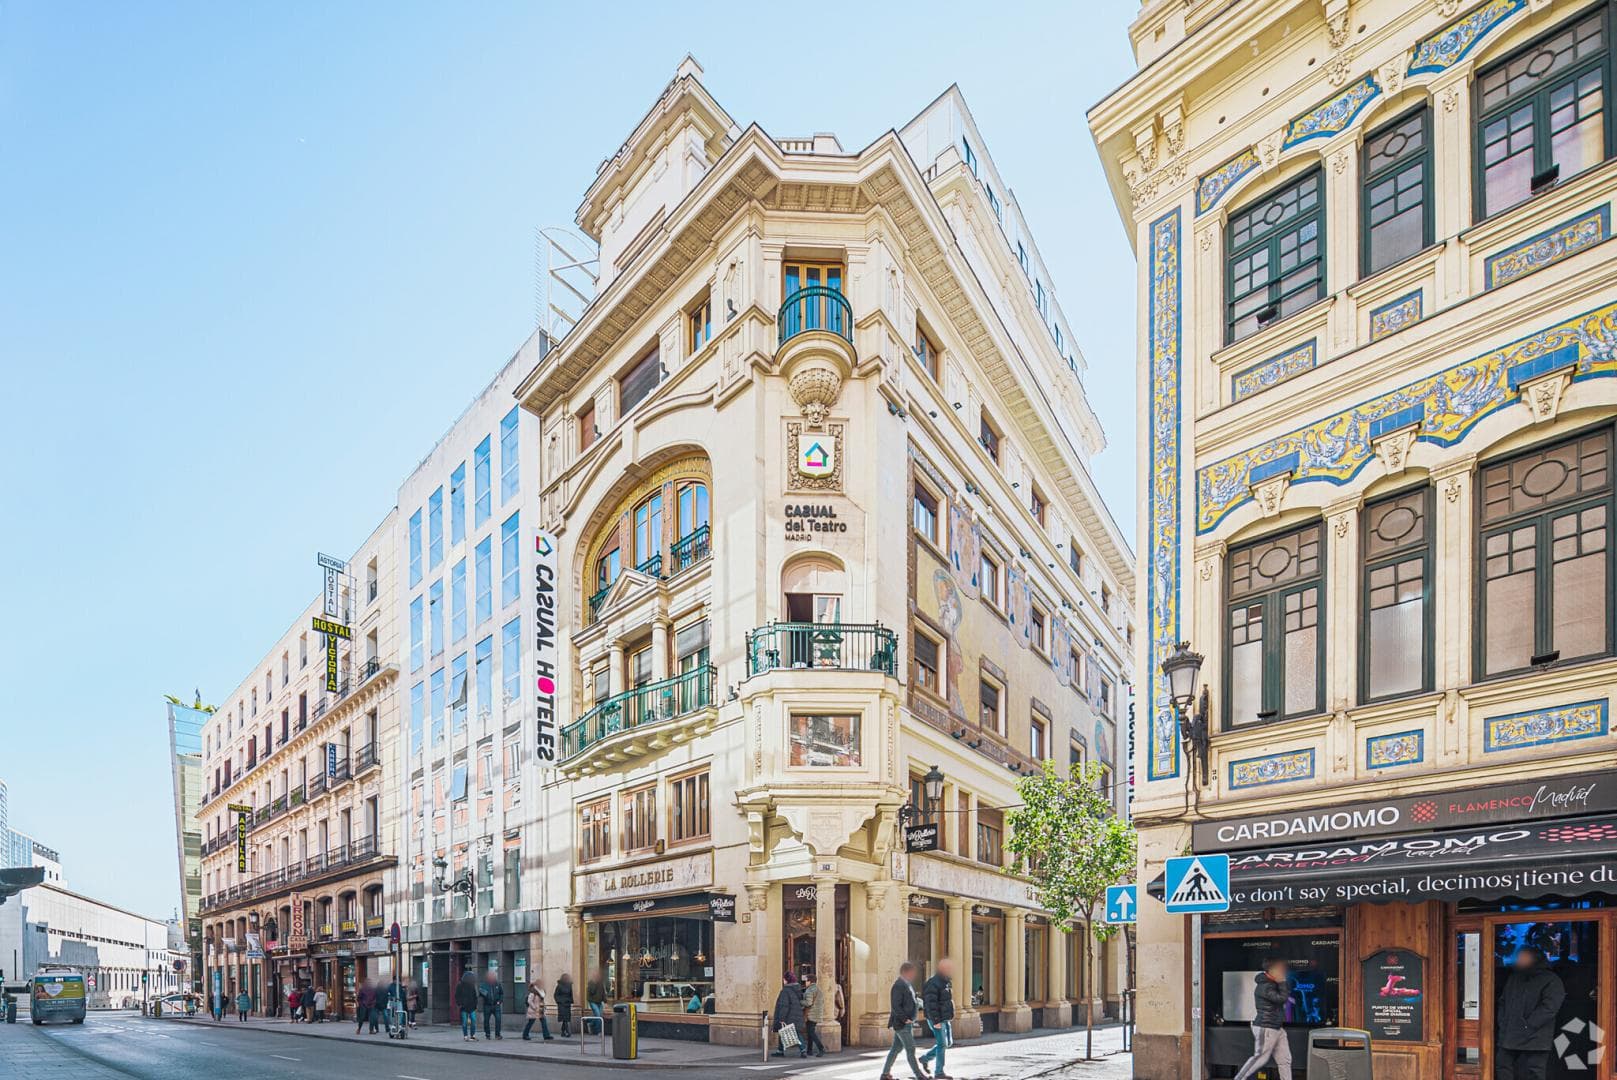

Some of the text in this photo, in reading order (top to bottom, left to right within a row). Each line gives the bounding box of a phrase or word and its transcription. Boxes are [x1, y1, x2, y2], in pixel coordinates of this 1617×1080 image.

[785, 505, 837, 518] CASUAL
[785, 519, 847, 533] del Teatro
[785, 534, 812, 542] MADRID
[319, 556, 343, 570] ASTORIA
[327, 568, 335, 613] HOSTAL
[313, 619, 351, 638] HOSTAL
[328, 635, 337, 686] VICTORIA
[536, 564, 555, 762] CASUAL HOTELES
[1217, 783, 1596, 843] CARDAMOMO FLAMENCO Madrid
[238, 817, 246, 868] AGUILAR
[605, 878, 617, 891] LA
[1299, 886, 1331, 902] say
[1336, 877, 1410, 900] special,
